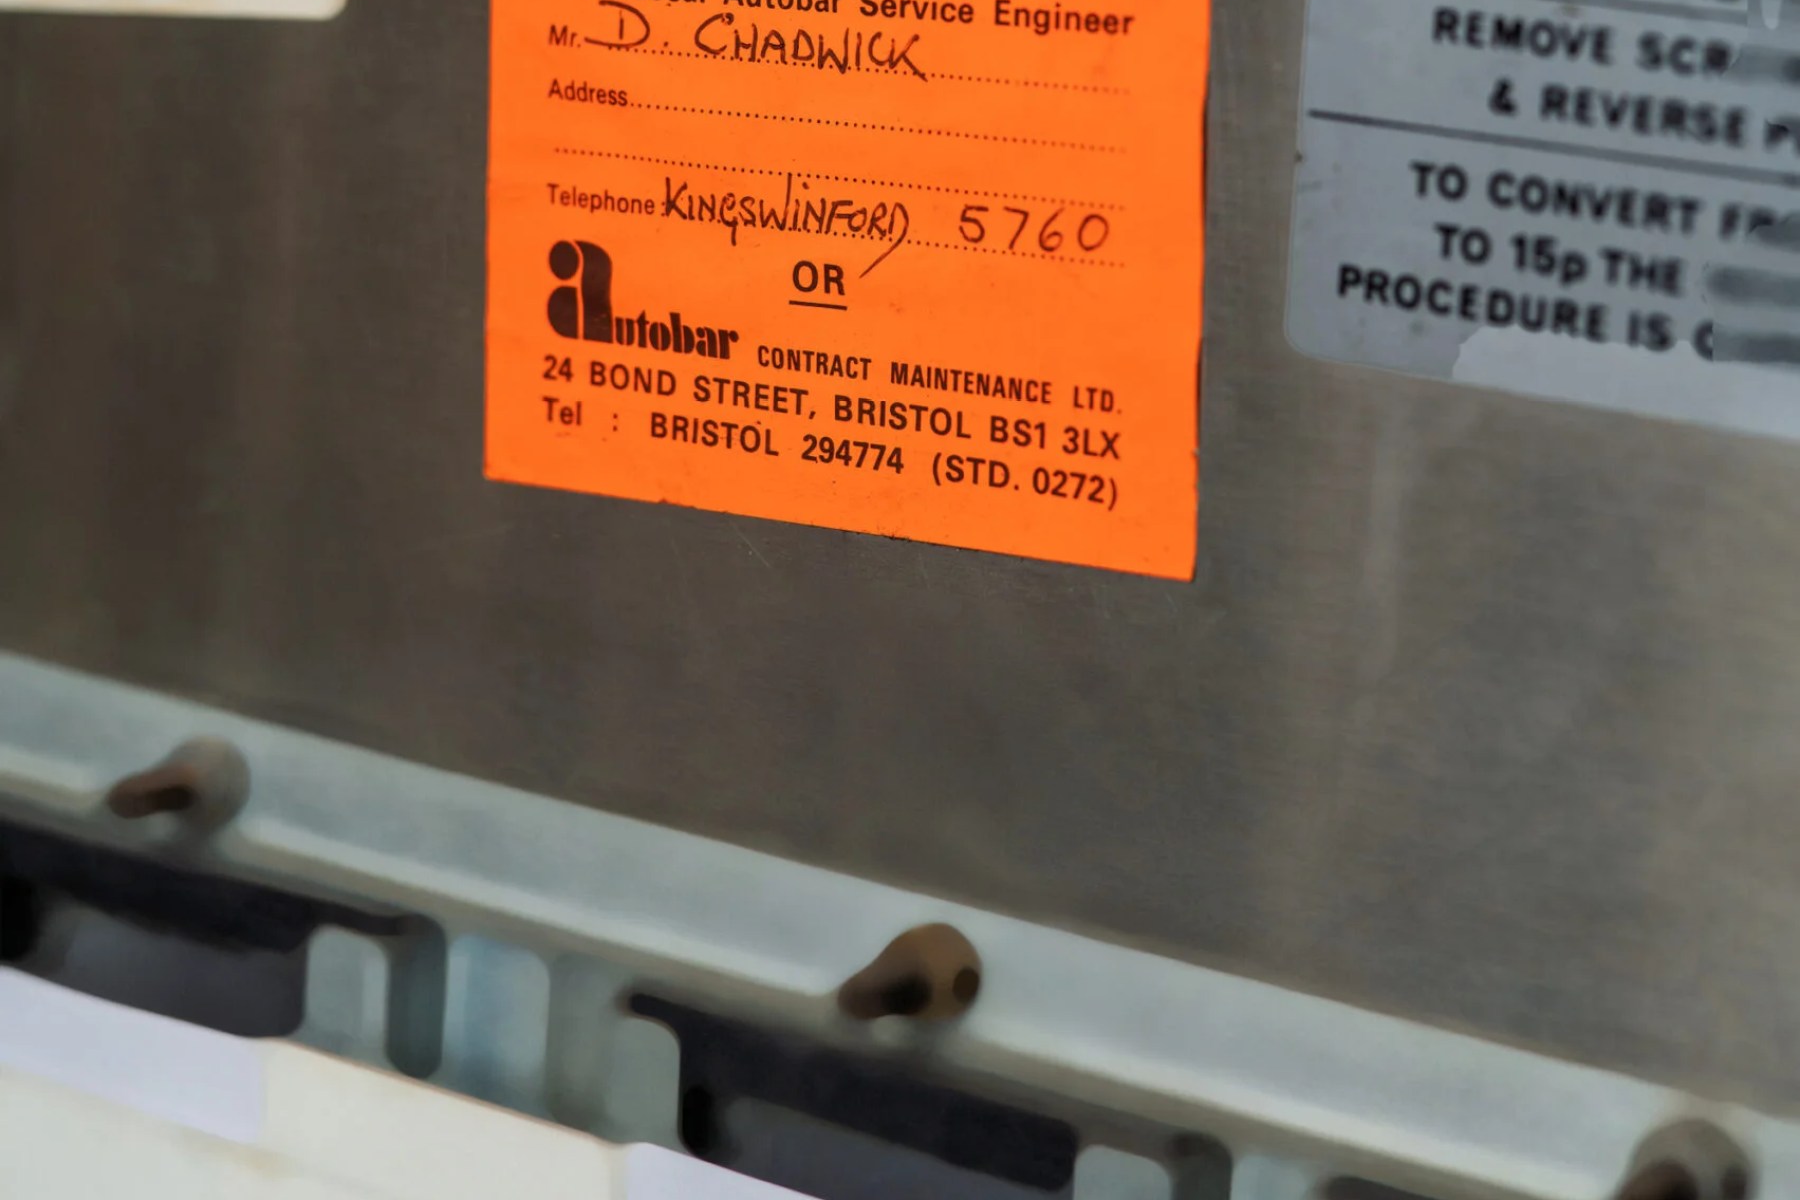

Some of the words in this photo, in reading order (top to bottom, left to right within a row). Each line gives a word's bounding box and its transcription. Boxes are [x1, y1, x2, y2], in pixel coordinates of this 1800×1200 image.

[549, 24, 582, 49] Mr.
[695, 12, 928, 82] CHADWICK
[1432, 7, 1613, 66] REMOVE
[548, 79, 629, 108] Address
[1487, 78, 1517, 118] &
[1540, 83, 1747, 149] REVERSE
[959, 206, 1109, 253] 5760
[1410, 161, 1469, 201] TO
[1487, 172, 1702, 232] CONVERT
[791, 261, 845, 296] OR
[1434, 223, 1492, 266] TO
[1510, 234, 1588, 288] 15p
[1600, 249, 1686, 297] THE
[1337, 264, 1610, 341] PROCEDURE
[1627, 311, 1677, 353] IS
[542, 354, 573, 382] 24
[589, 360, 676, 396] BOND
[693, 376, 817, 421] STREET,
[834, 395, 971, 439] BRISTOL
[989, 417, 1046, 449] BS1
[1062, 426, 1121, 460] 3LX
[757, 345, 872, 380] CONTRACT
[890, 363, 1051, 405] MAINTENANCE
[1073, 385, 1122, 414] LTD.
[542, 398, 581, 426] Tel
[649, 412, 778, 455] BRISTOL
[800, 435, 905, 474] 294774
[932, 453, 1019, 492] (STD.
[1032, 467, 1118, 510] 0272)
